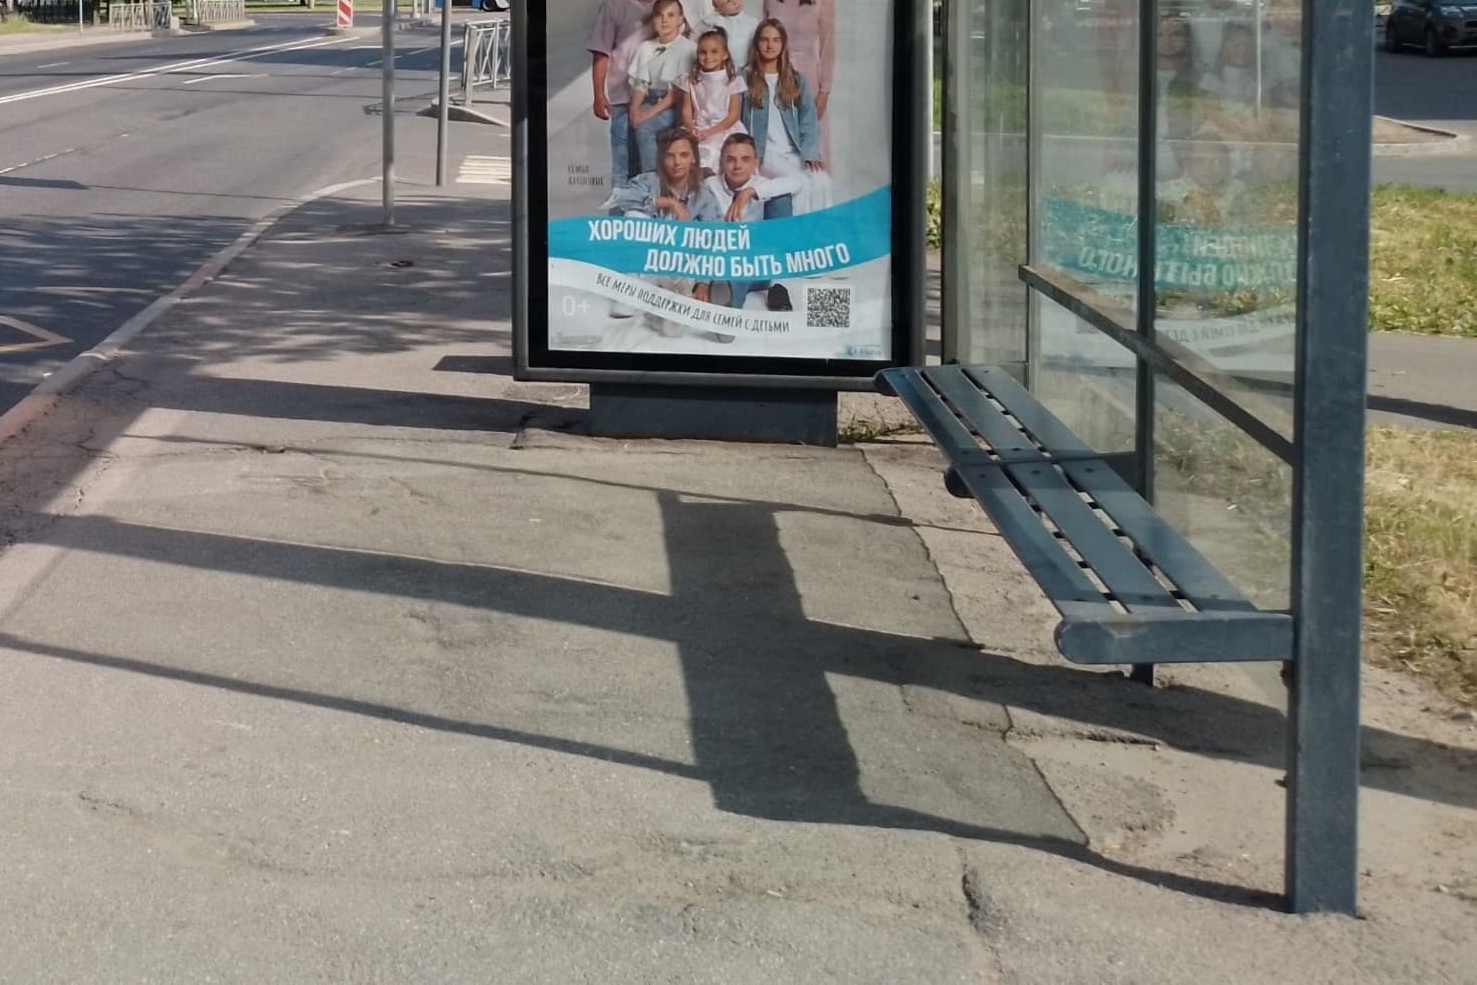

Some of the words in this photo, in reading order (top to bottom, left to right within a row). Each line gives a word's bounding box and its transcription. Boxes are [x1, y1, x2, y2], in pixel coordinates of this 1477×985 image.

[588, 219, 676, 246] ХОРОШИХ
[681, 225, 751, 252] ЛЮДЕЙ
[643, 248, 723, 278] ДОЛЖНО
[730, 254, 782, 278] БЫТЬ
[785, 242, 851, 274] МНОГО
[562, 295, 592, 316] 0+
[596, 272, 611, 288] ВСЕ
[613, 279, 636, 297] МЕРЫ
[638, 287, 692, 316] ПОДДЕРЖКИ
[691, 308, 711, 322] ДЛЯ
[712, 312, 743, 330] СЕМЕЙ
[744, 318, 751, 331] С
[751, 318, 790, 333] ДЕТЬМИ
